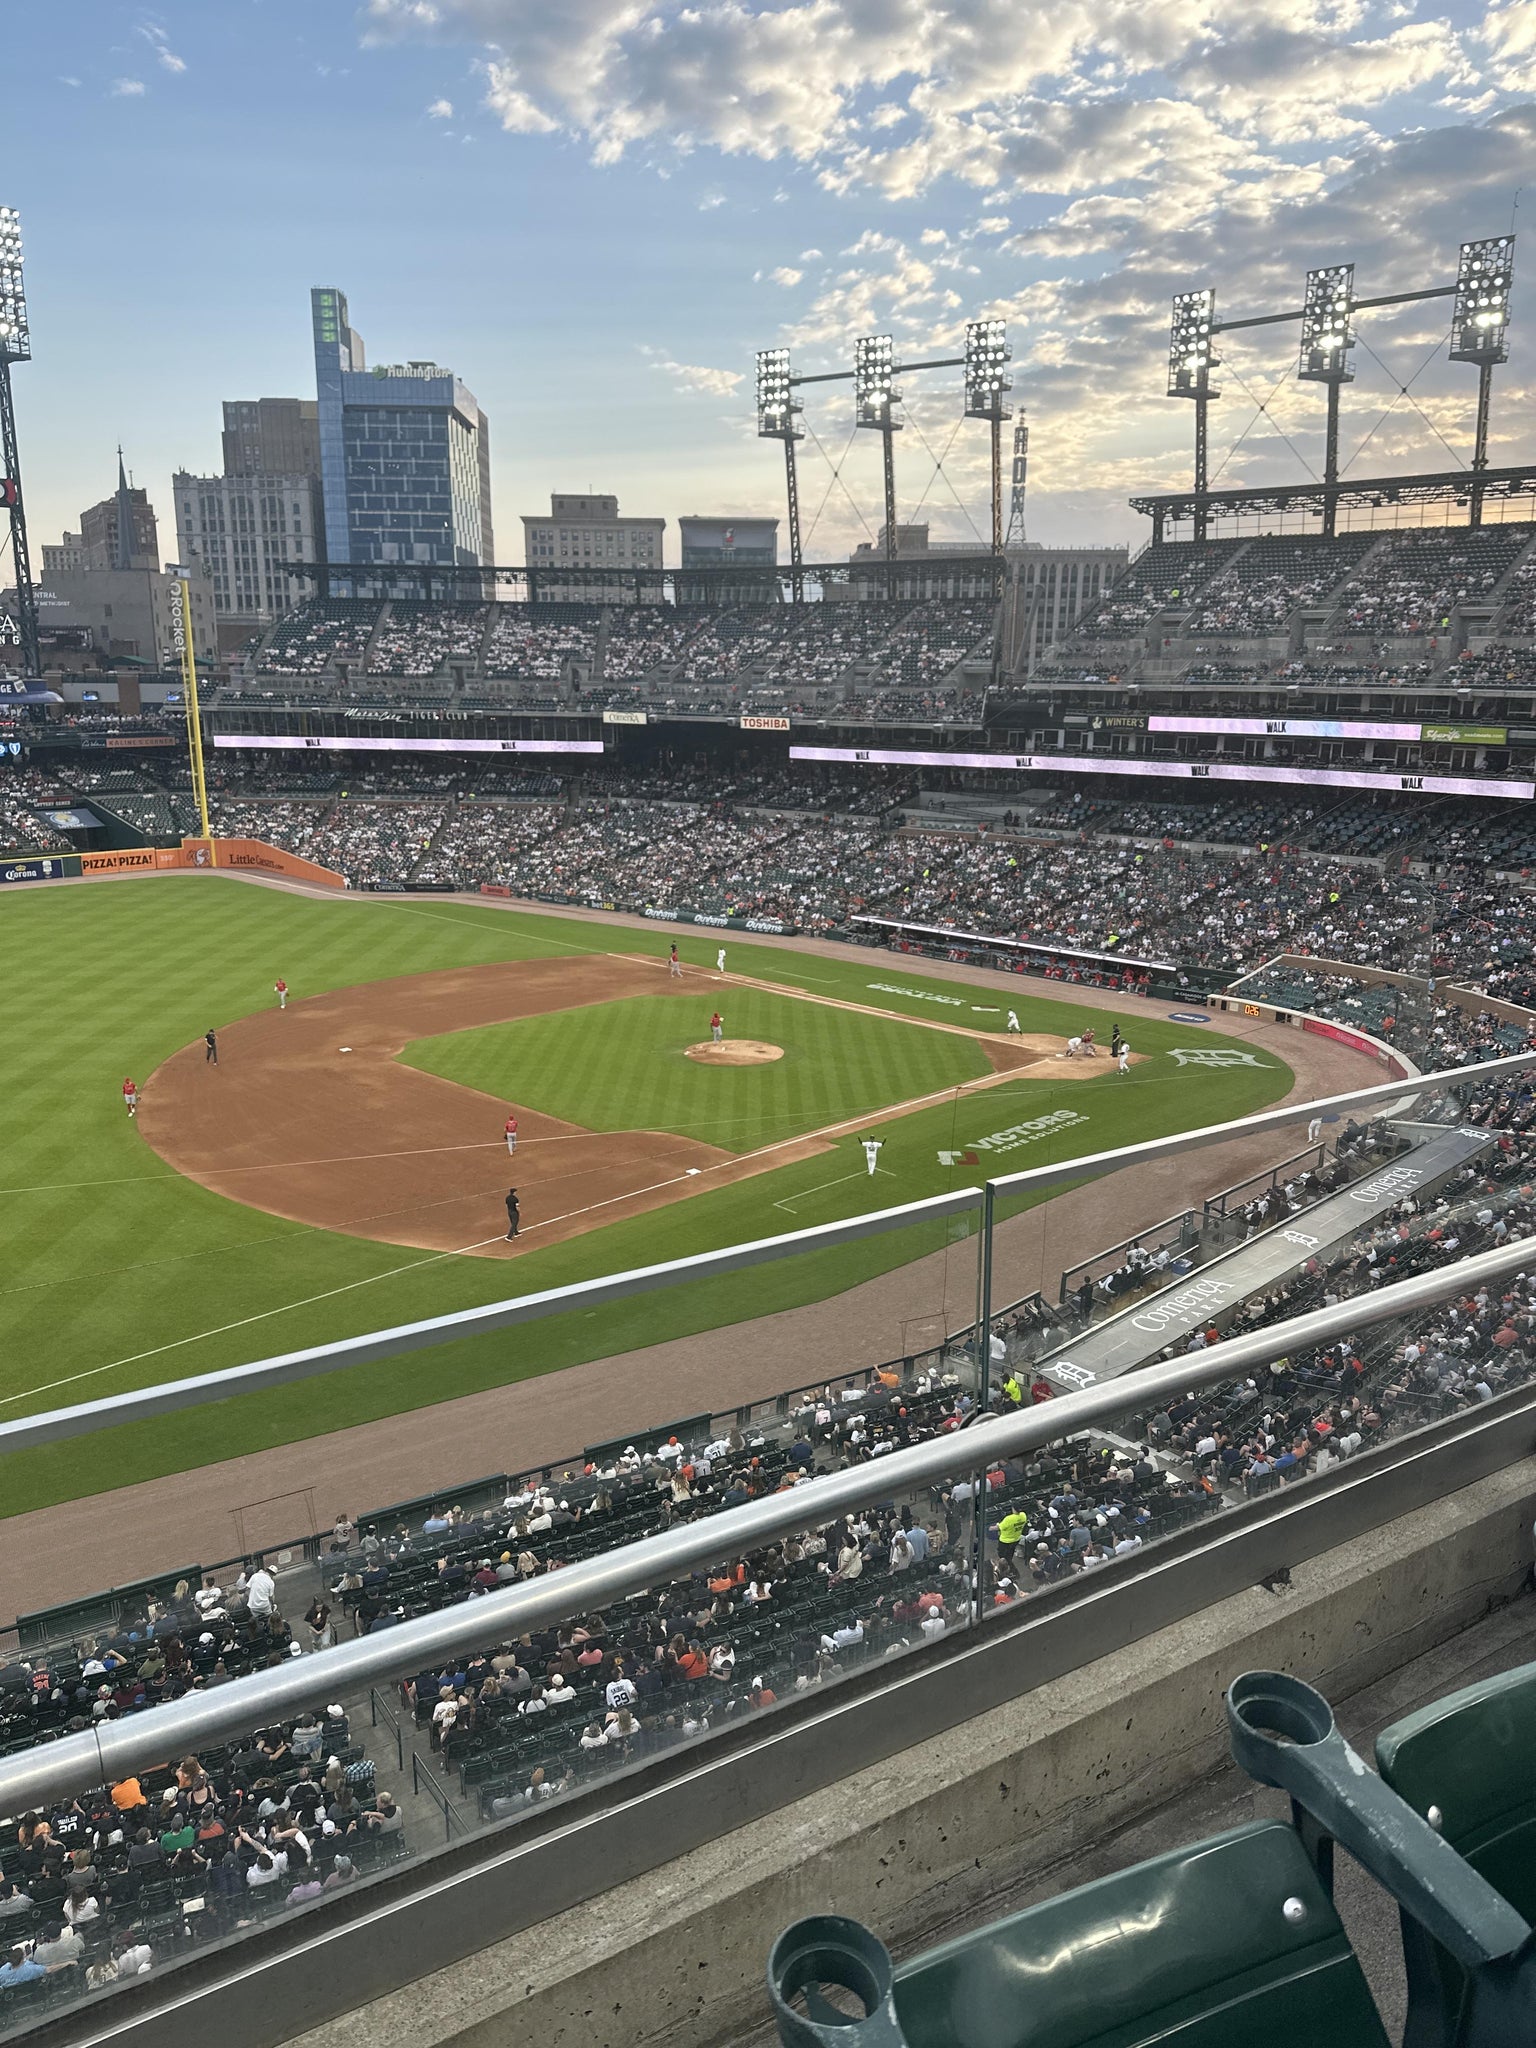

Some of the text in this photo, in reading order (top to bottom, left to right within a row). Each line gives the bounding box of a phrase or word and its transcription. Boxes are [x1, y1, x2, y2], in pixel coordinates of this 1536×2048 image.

[388, 366, 449, 381] Huntington
[169, 597, 187, 653] Rocket
[446, 712, 467, 720] CLUB
[743, 718, 788, 729] TOSHIBA
[1105, 717, 1145, 728] WINTER'S
[1266, 721, 1287, 733] WALK
[1191, 765, 1210, 776] WALK
[1401, 777, 1424, 789] WALK
[83, 855, 153, 870] PIZZA! PIZZA!
[5, 869, 37, 881] Corona
[591, 901, 615, 911] bet365
[964, 1109, 1078, 1150] VICTORS
[993, 1115, 1090, 1154] HOME SOLUTIONS
[1180, 1298, 1225, 1324] PARK
[613, 1692, 630, 1707] 29
